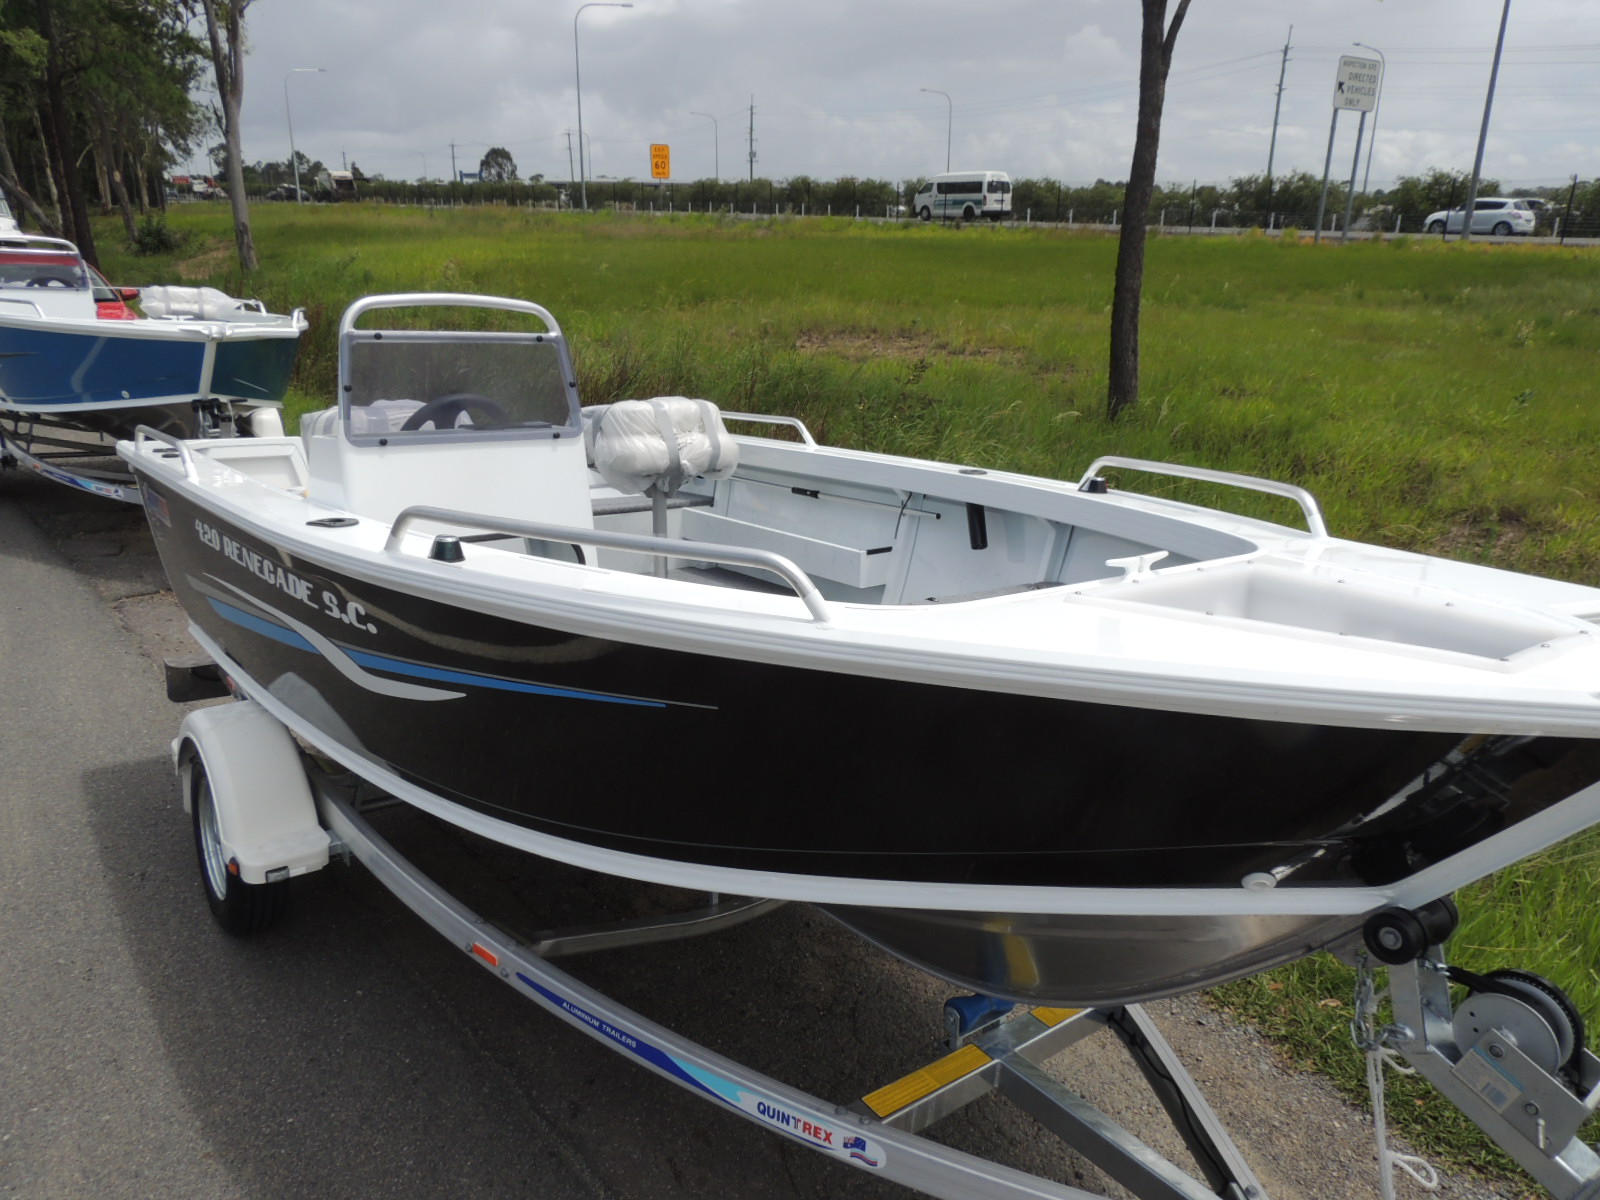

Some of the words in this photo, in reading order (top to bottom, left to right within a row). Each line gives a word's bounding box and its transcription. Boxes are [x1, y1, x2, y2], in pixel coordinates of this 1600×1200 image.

[1348, 72, 1376, 84] DIRECTED
[1346, 85, 1375, 96] VEHICLES
[1344, 98, 1360, 106] ONLY
[655, 161, 665, 169] 60
[196, 519, 220, 551] 420
[222, 535, 318, 610] RENEGADE
[322, 590, 378, 634] S.C.
[562, 1002, 600, 1028] ALUMINIUM
[602, 1024, 637, 1048] TRAILERS
[757, 1102, 832, 1144] QUINTREX
